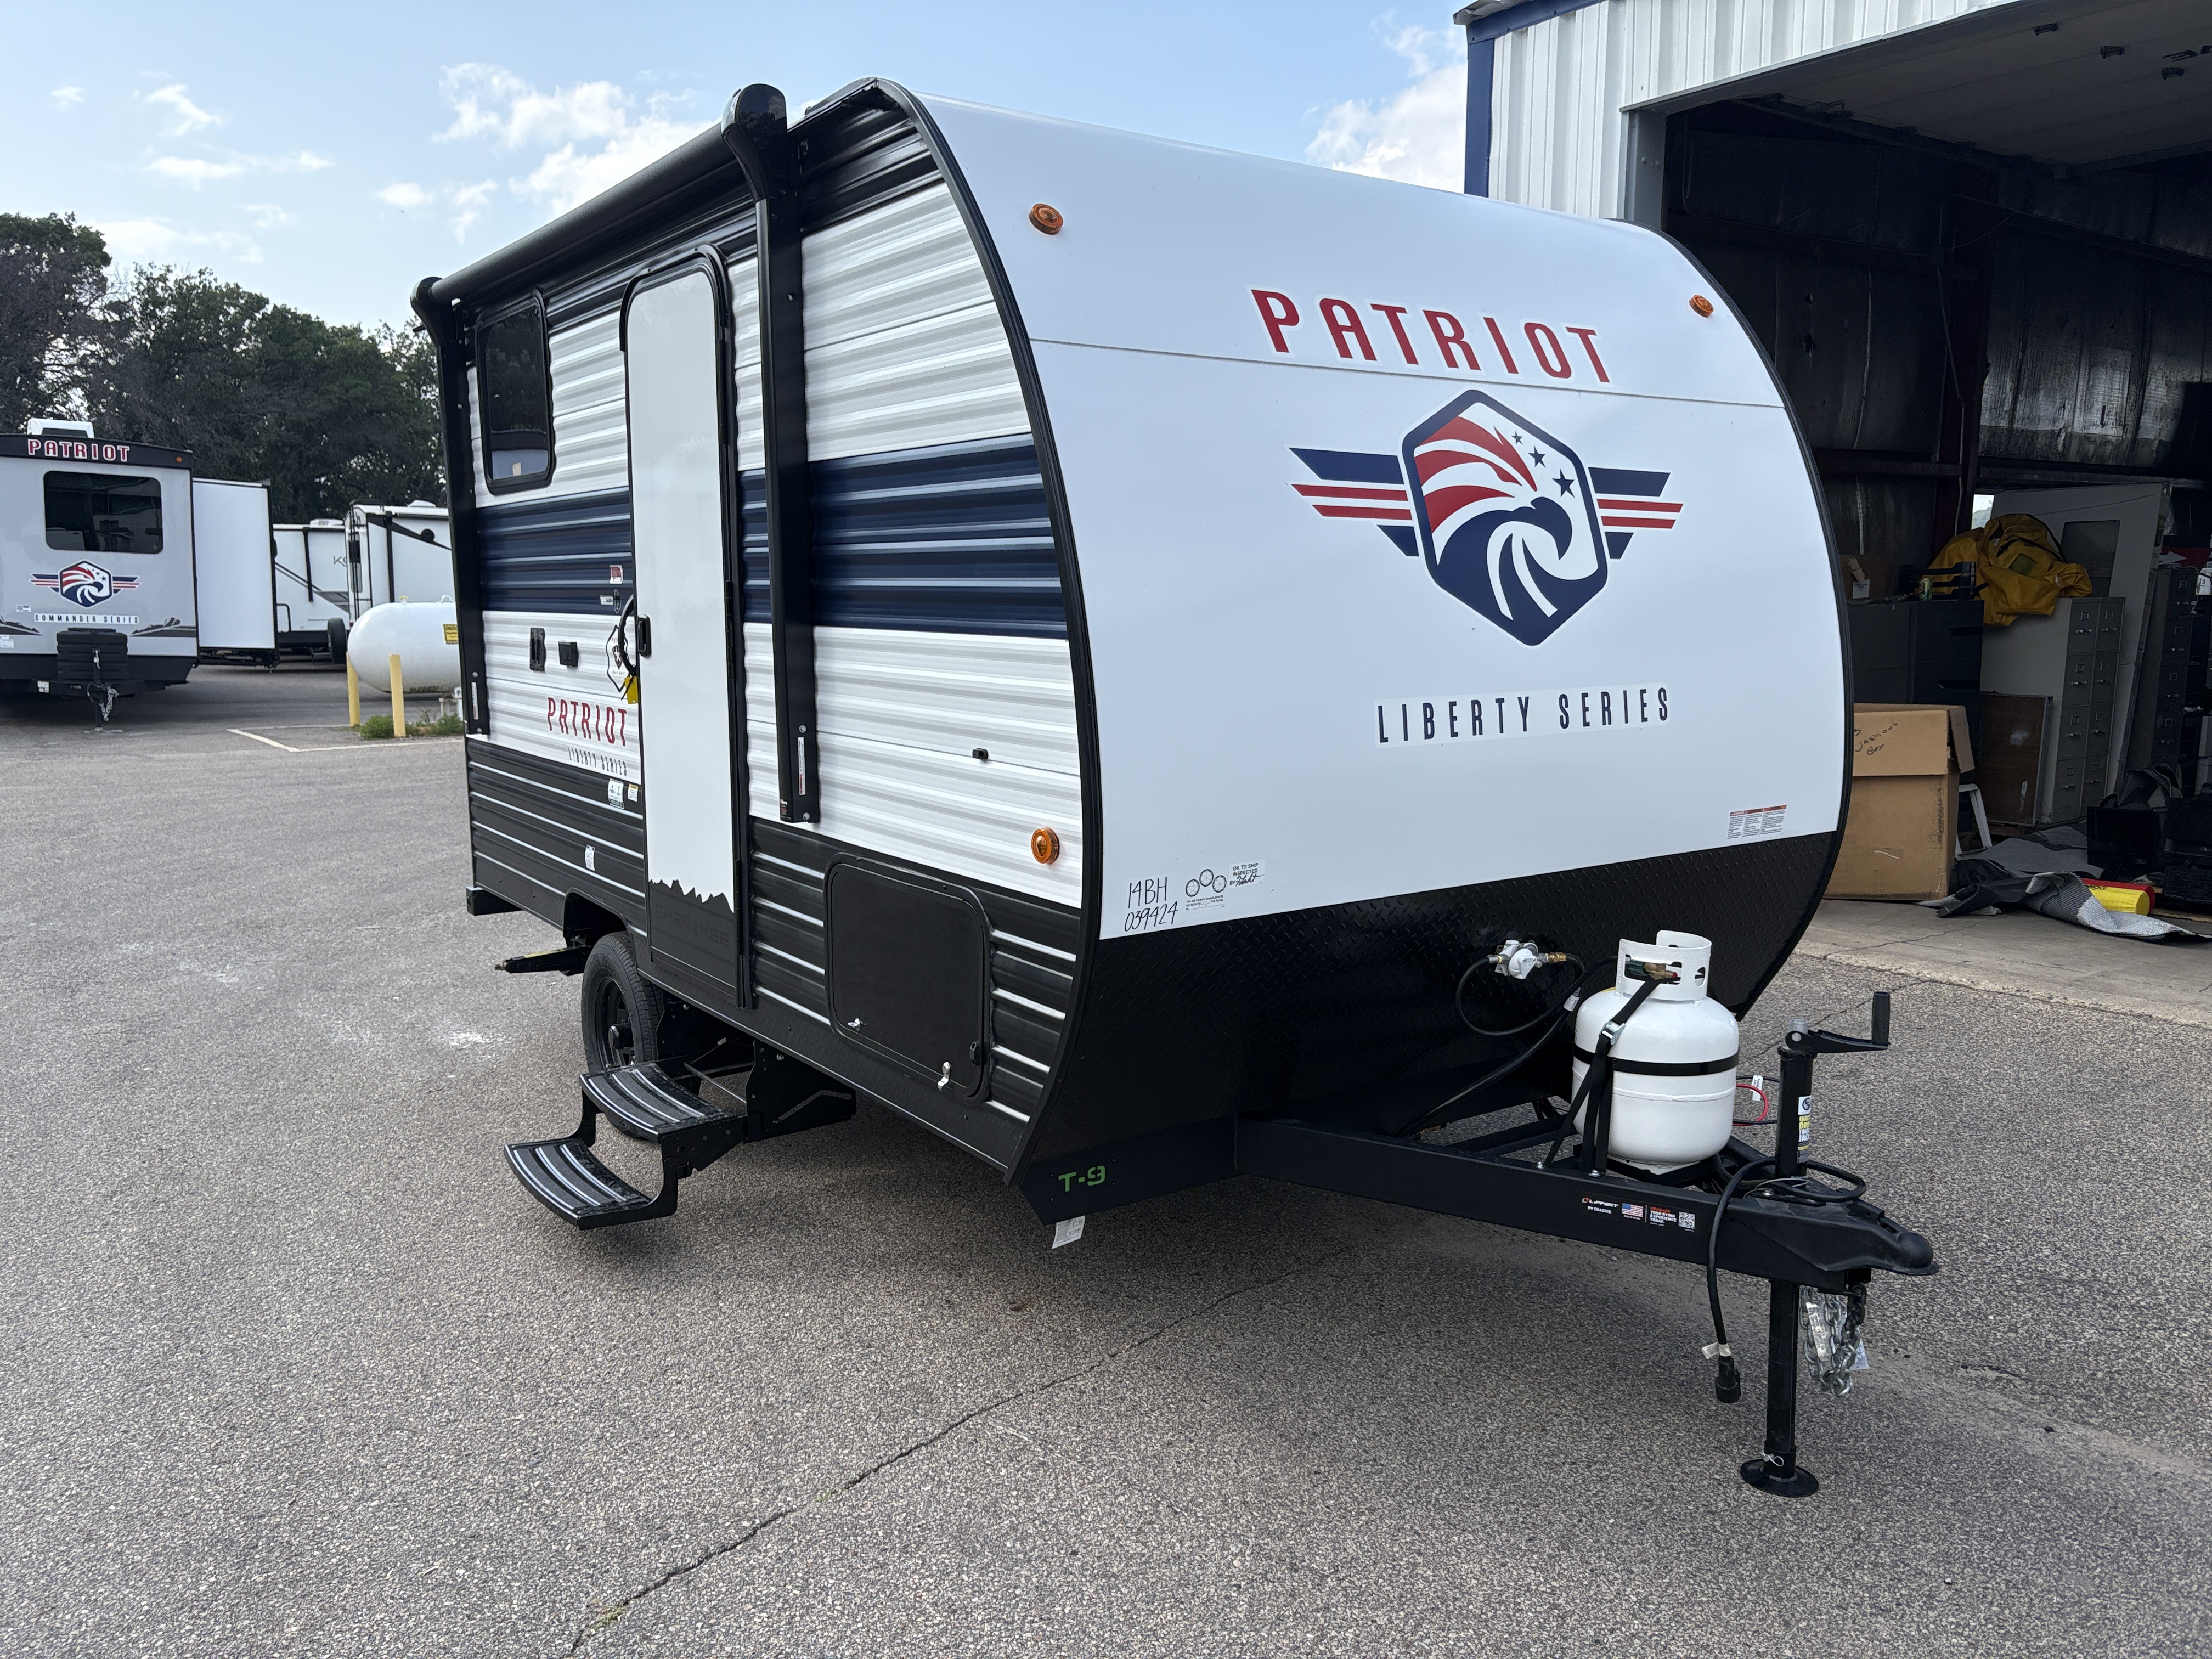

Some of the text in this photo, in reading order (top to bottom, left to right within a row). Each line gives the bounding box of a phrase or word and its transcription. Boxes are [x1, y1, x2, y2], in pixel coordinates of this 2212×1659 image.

[1250, 289, 1611, 383] PATRIOT
[27, 439, 130, 462] PATRIOT
[35, 614, 96, 623] COMMANDER
[547, 697, 627, 747] PATRIOT
[1378, 687, 1668, 743] LIBERTY SERIES
[567, 746, 627, 777] LIBERTY SERIES
[1232, 868, 1258, 877] INSPECTED
[1124, 901, 1179, 932] 039424
[1058, 1165, 1106, 1192] T-9
